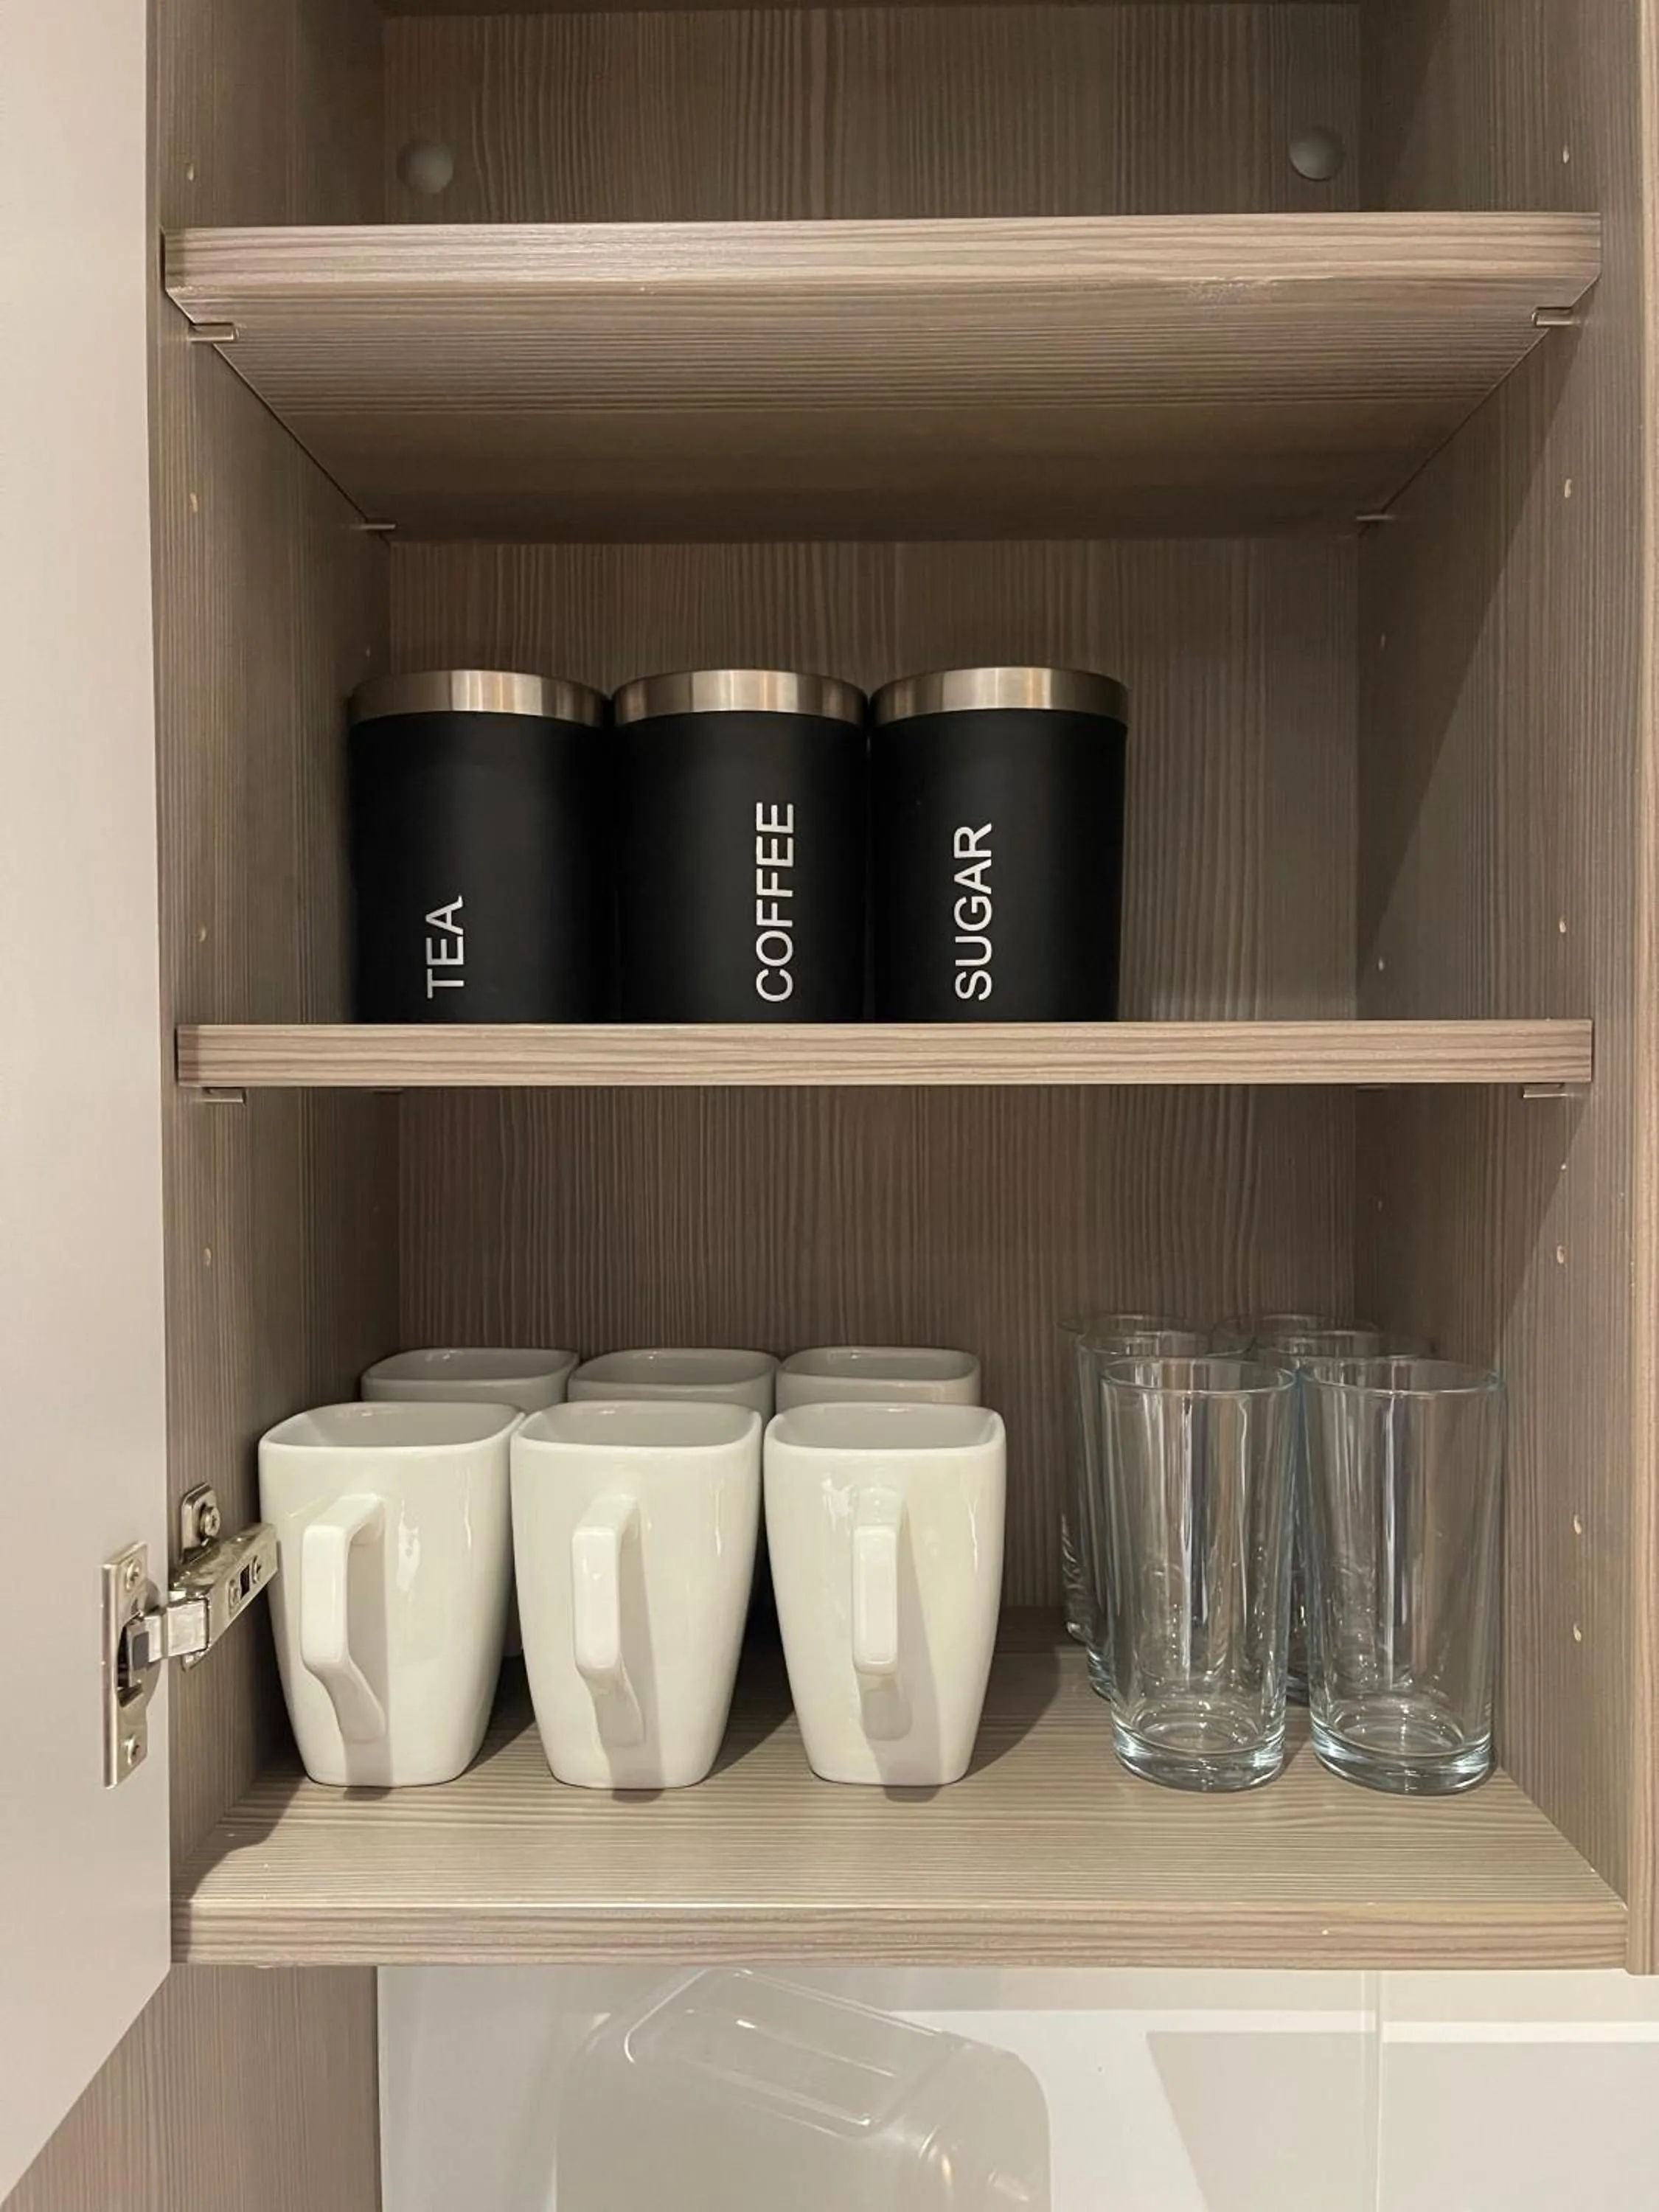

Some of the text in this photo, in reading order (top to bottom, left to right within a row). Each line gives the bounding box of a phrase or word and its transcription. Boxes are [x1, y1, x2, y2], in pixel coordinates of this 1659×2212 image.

[425, 895, 464, 998] TEA
[756, 801, 794, 1002] COFFEE
[953, 823, 992, 1001] SUGAR
